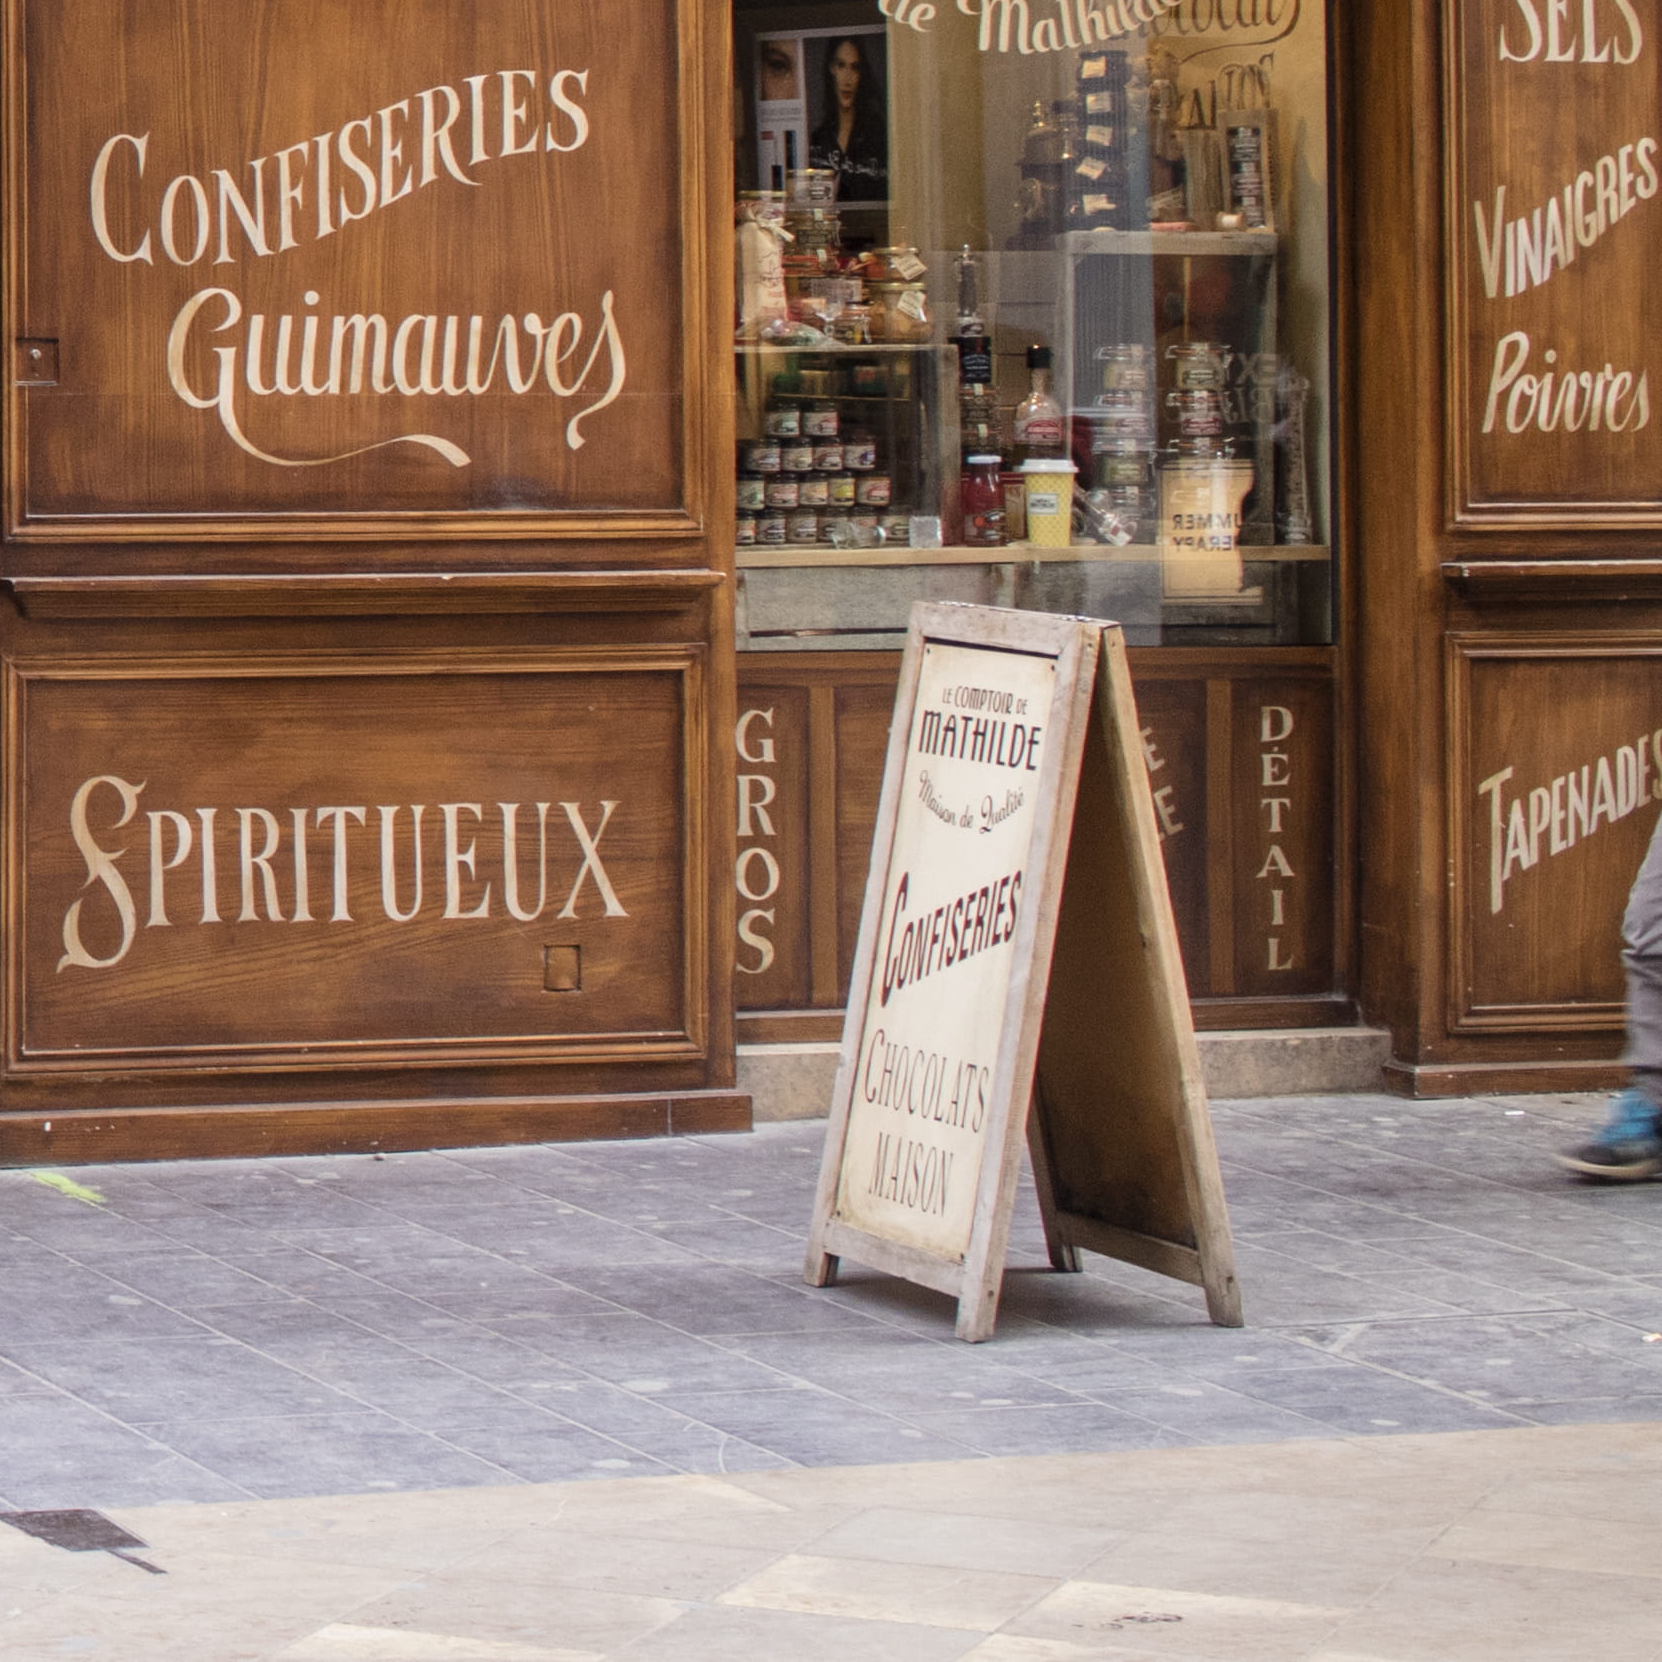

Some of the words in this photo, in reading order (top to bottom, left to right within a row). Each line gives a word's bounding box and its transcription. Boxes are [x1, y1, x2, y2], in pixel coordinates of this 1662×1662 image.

[90, 68, 590, 267] CONFISERIES
[1474, 137, 1659, 298] VINAIGRES
[167, 287, 627, 468] Guimauves
[1482, 331, 1650, 434] Poivres
[918, 710, 1042, 771] MATHILDE
[942, 687, 952, 704] LE
[954, 686, 1014, 715] COMPTOIR
[1016, 698, 1028, 715] DE
[735, 708, 779, 976] GROS
[918, 769, 957, 826] Maison
[959, 804, 974, 829] de
[979, 786, 1024, 835] Qualité
[57, 774, 629, 975] SPIRITUEUX
[880, 870, 1023, 1009] CONFISERIES
[864, 1028, 989, 1135] CHOCOLATS
[868, 1130, 954, 1218] MAISON
